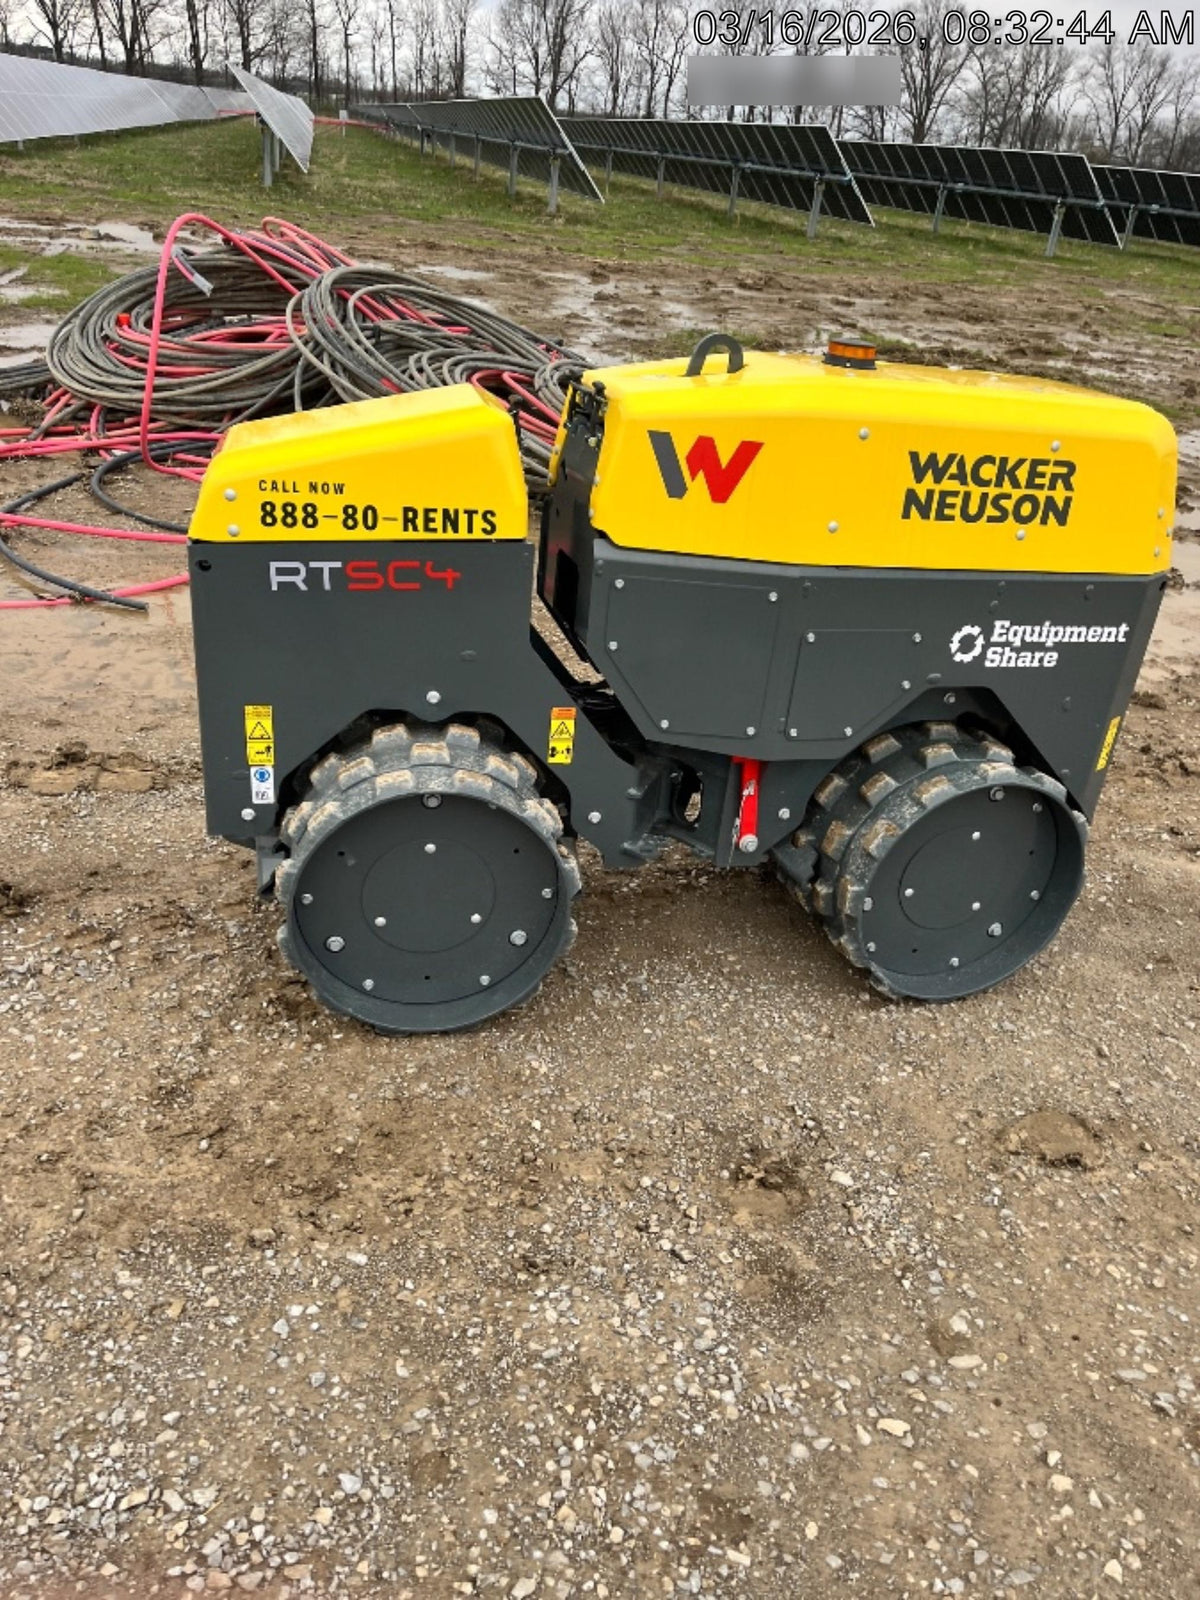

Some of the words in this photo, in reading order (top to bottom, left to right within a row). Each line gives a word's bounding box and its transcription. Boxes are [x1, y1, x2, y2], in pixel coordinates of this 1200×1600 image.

[258, 479, 300, 494] CALL
[308, 481, 346, 495] NOW
[908, 450, 1077, 492] WACKER
[260, 500, 498, 536] 888-80-RENTS
[901, 487, 1074, 527] NEUSON
[269, 560, 462, 592] RTSC4
[990, 619, 1130, 646] Equipment
[984, 646, 1059, 669] Share
